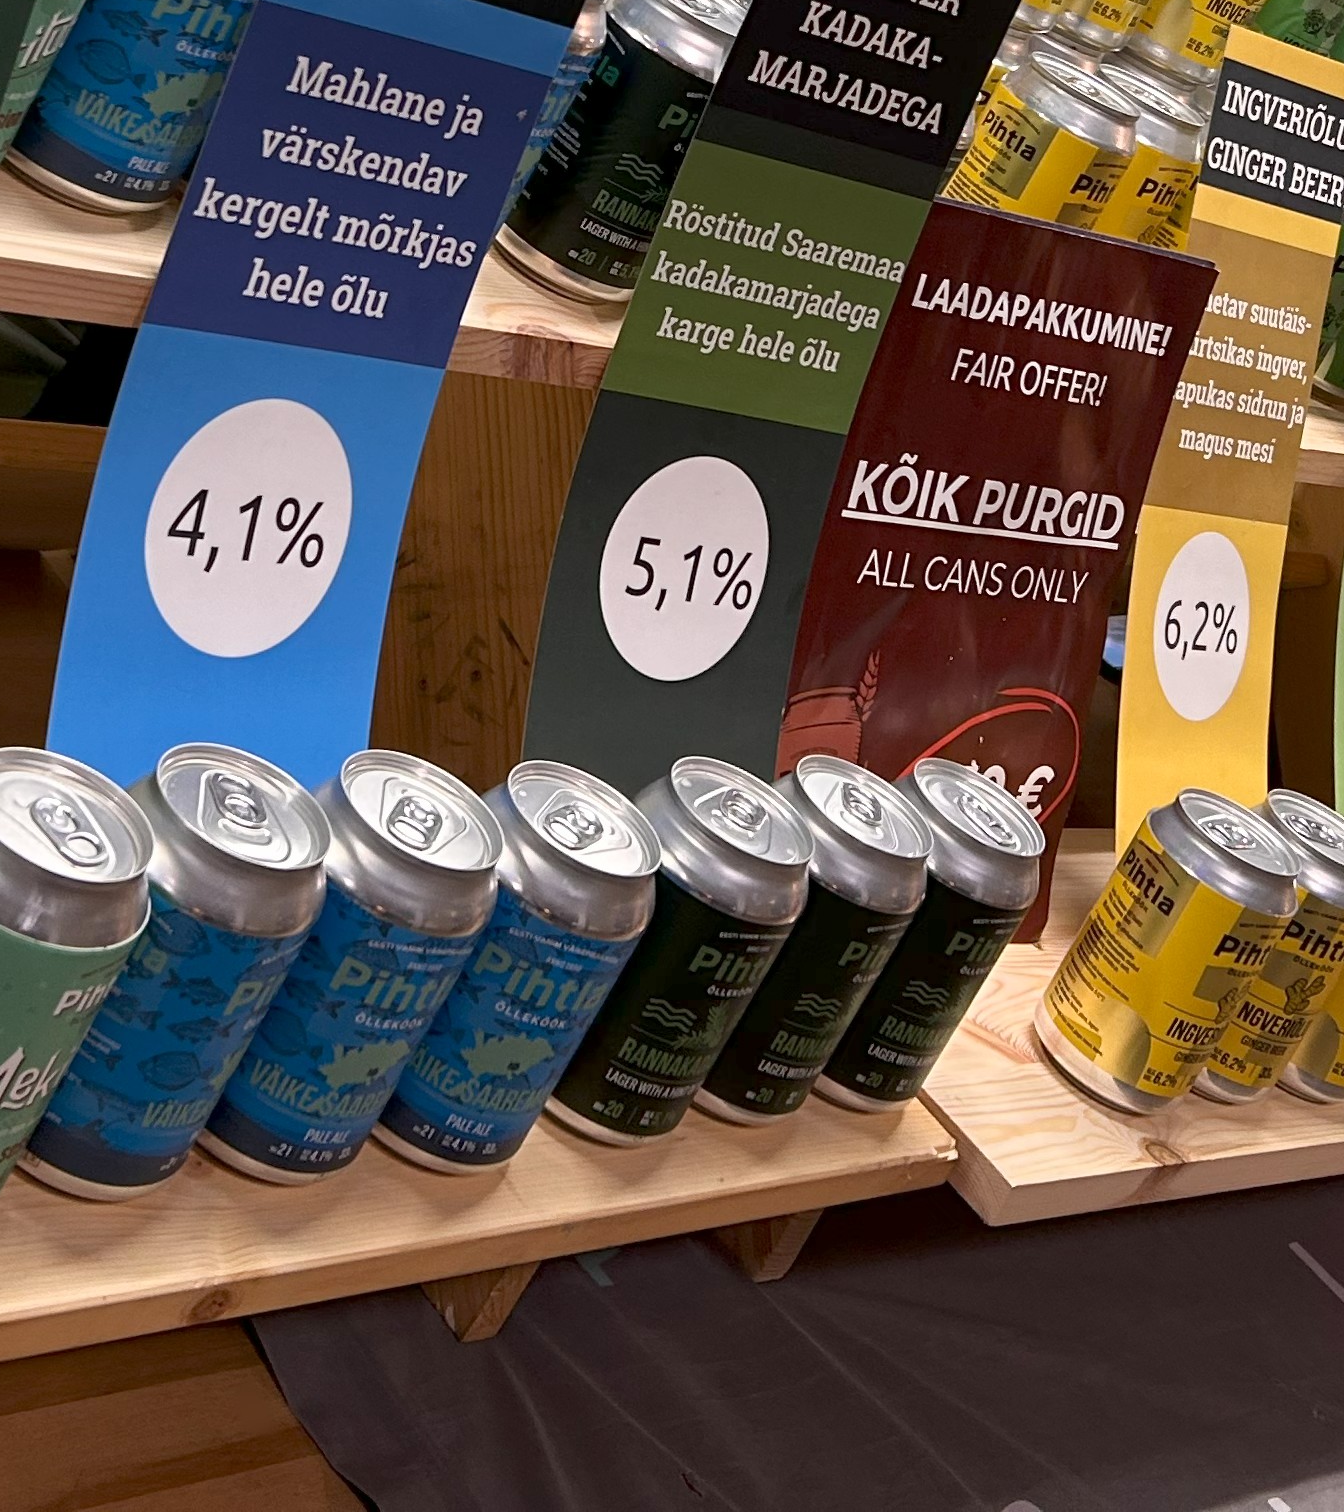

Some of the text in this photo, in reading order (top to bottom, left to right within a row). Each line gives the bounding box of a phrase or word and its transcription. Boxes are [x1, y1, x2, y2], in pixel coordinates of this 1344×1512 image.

[798, 0, 943, 70] KADAKA-
[285, 55, 484, 140] Mahlane ja
[746, 50, 945, 135] MARJADEGA
[260, 125, 469, 199] värskendav
[980, 108, 1038, 163] Pihtla
[1207, 136, 1287, 190] GINGER
[193, 177, 477, 270] kergelt mõrkjas
[580, 218, 611, 246] LAGER
[662, 198, 906, 284] Röstitud Saaremaa
[242, 257, 390, 319] hele õlu
[650, 250, 882, 333] kadakamarjadega
[910, 272, 1174, 357] LAADAPAKKUMINE!
[1249, 304, 1312, 335] suutäis-
[656, 306, 842, 374] karge hele õlu
[1255, 344, 1308, 385] ingver,
[951, 348, 1108, 408] FAIR OFFER!
[1173, 379, 1305, 429] apukas sidrun ja
[1178, 426, 1276, 465] magus mesi
[167, 488, 326, 573] 4,1%
[846, 453, 1126, 542] KÕIK PURGID
[625, 535, 754, 613] 5,1%
[856, 548, 1089, 606] ALL CANS ONLY
[1163, 598, 1239, 662] 6,2%
[1122, 846, 1178, 918] Pihtla
[473, 941, 609, 1013] Pihtla
[604, 1067, 640, 1094] LAGER
